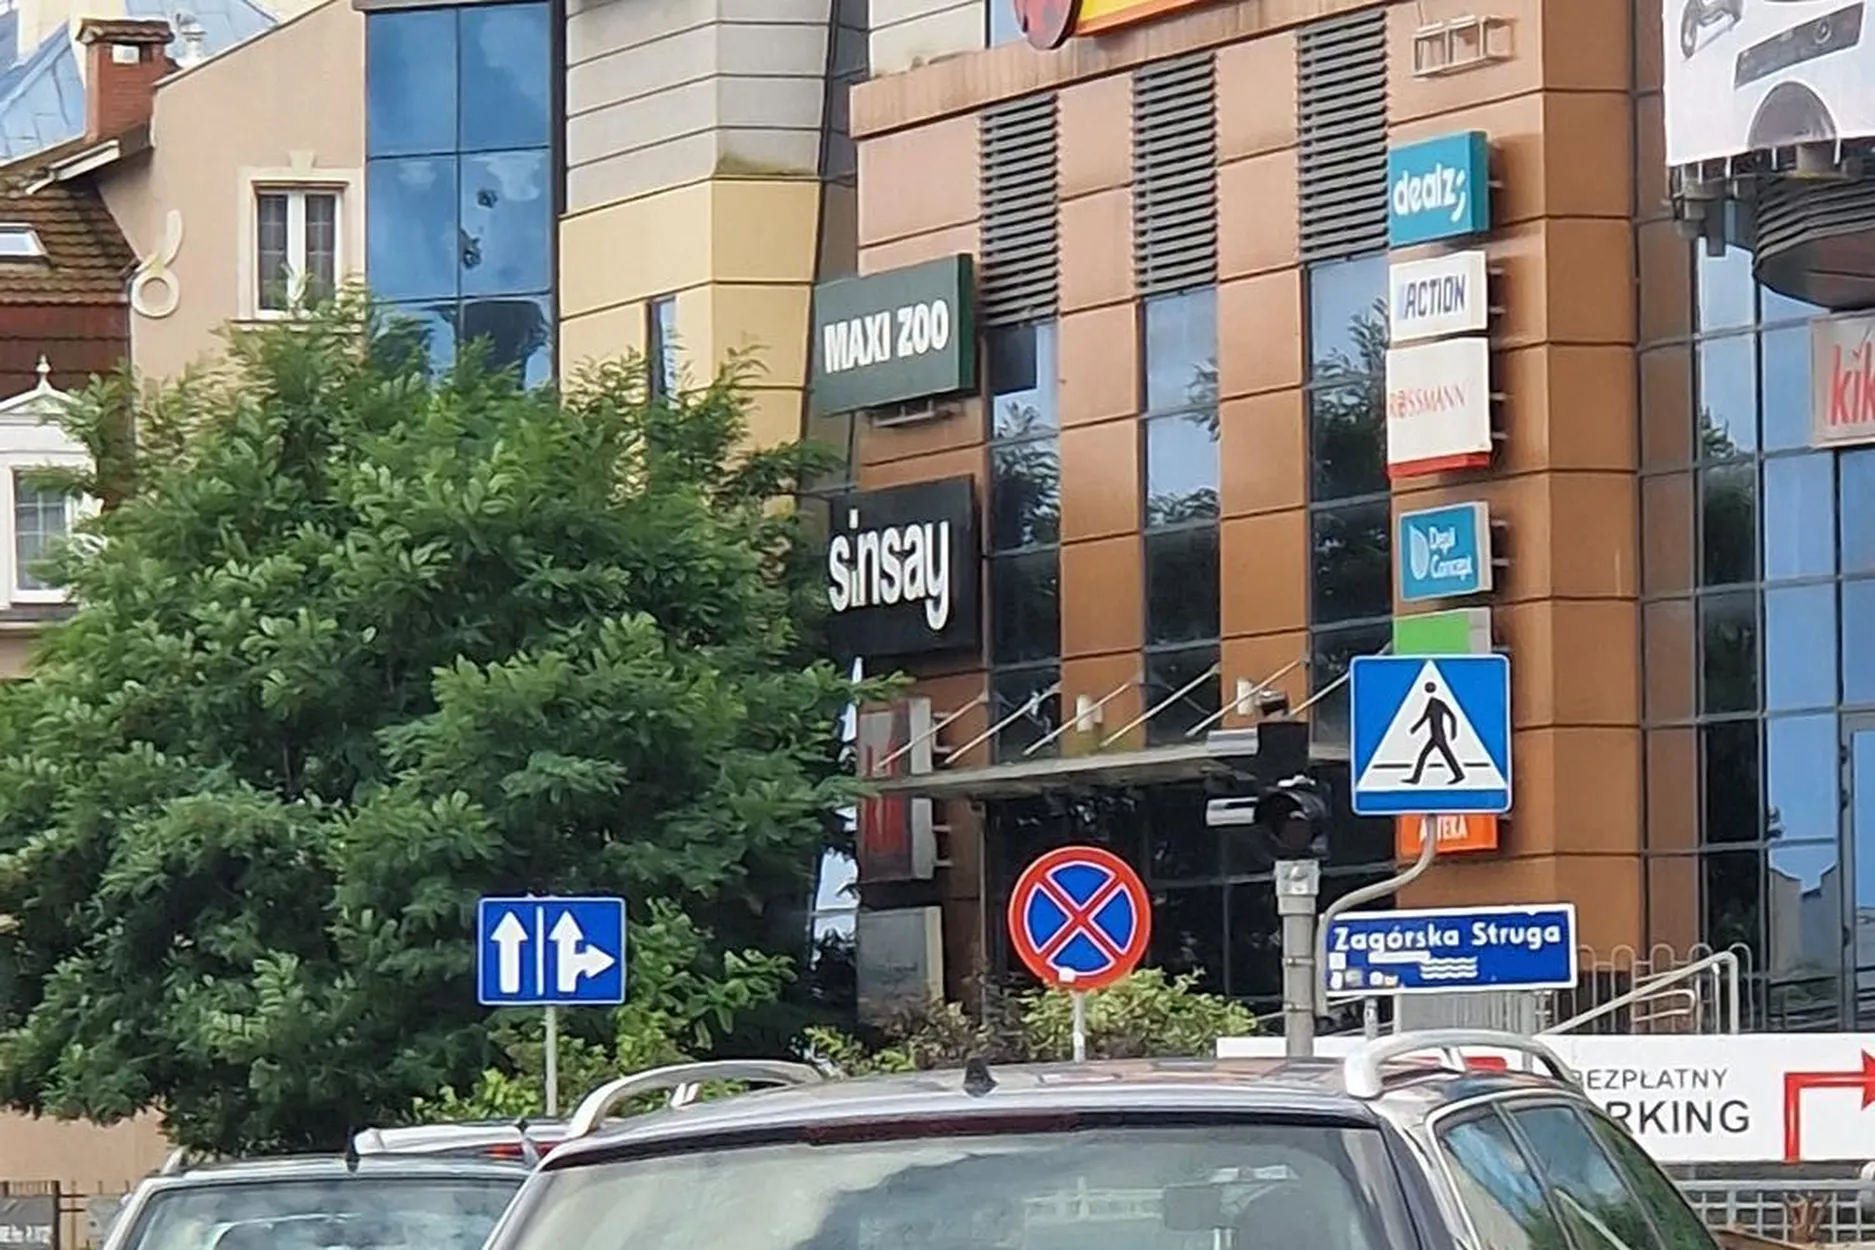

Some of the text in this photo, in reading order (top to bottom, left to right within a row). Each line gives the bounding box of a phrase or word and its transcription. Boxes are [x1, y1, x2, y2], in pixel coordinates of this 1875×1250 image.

[1403, 274, 1467, 320] ACTION
[823, 300, 949, 373] MAXI ZOO
[828, 508, 950, 630] sinsay
[1418, 814, 1468, 843] ATEKA
[1334, 921, 1561, 953] Zagórska Struga
[1605, 1100, 1750, 1134] RKING
